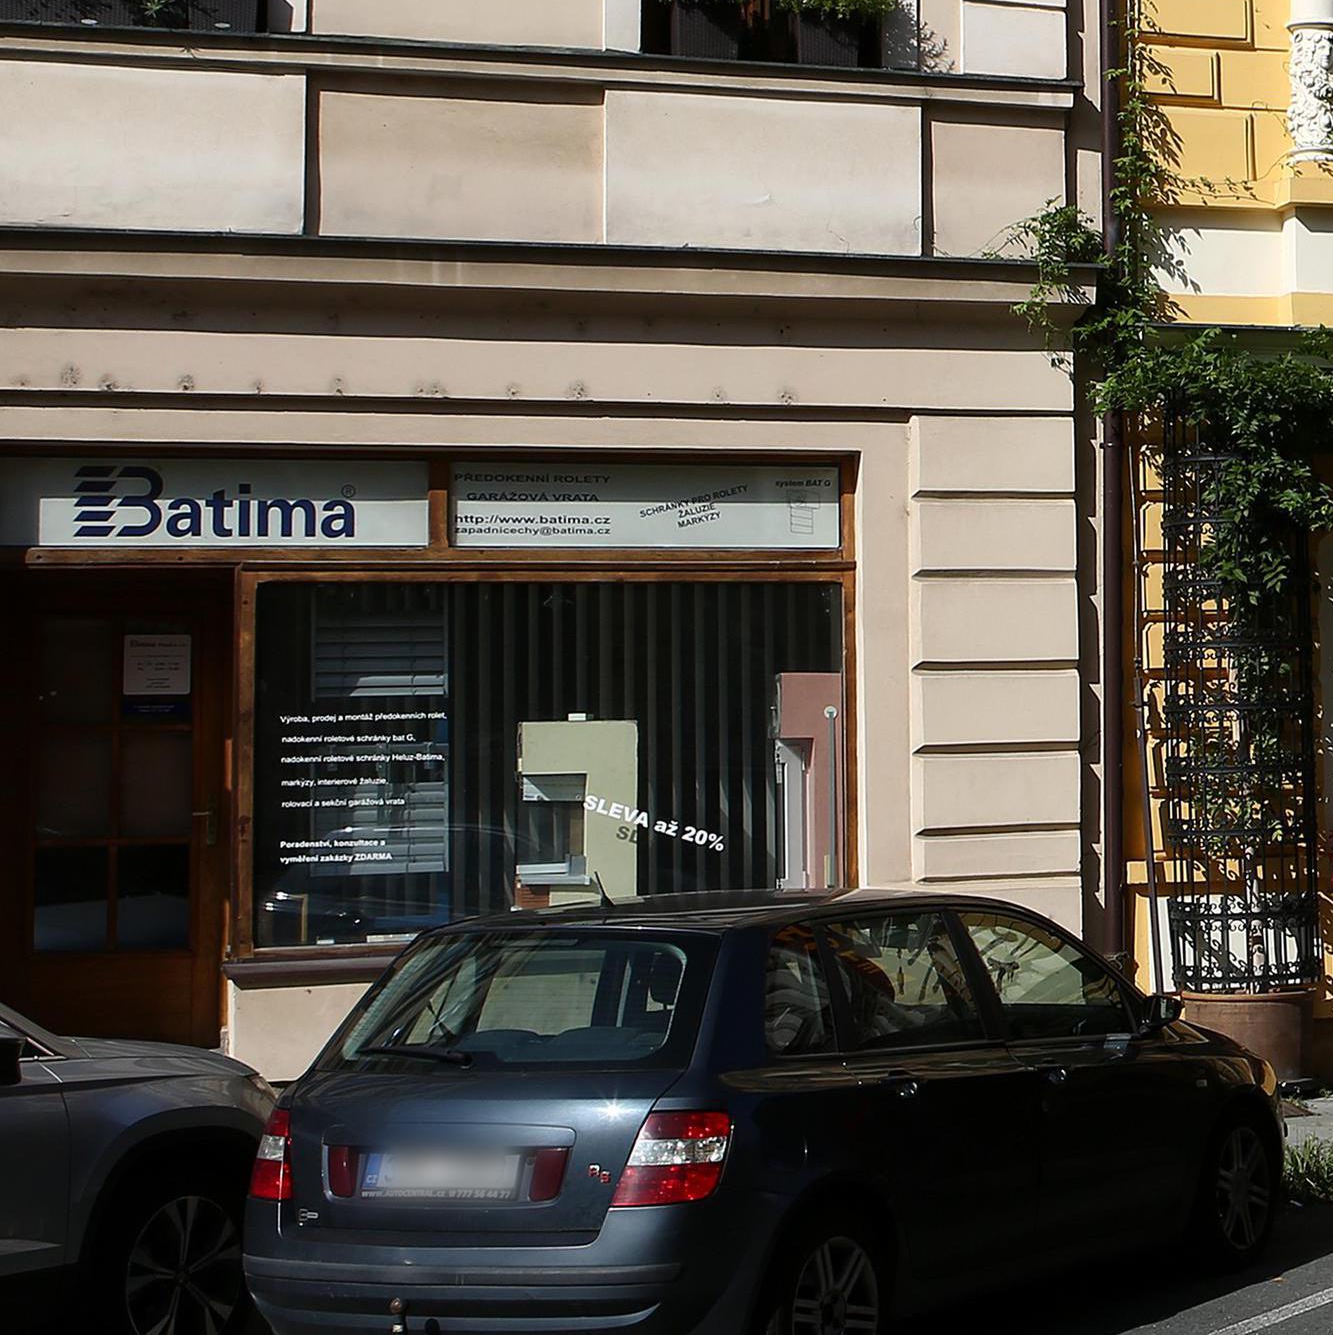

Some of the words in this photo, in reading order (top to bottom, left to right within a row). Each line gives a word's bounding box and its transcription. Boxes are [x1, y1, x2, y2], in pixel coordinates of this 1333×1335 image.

[454, 473, 549, 483] PŘEDOKENNÍ
[554, 474, 611, 483] ROLETY
[466, 492, 549, 502] GARÁŽOVÁ
[552, 493, 599, 502] VRATA
[691, 493, 711, 504] PRO
[713, 484, 749, 500] ROLETY
[73, 466, 355, 537] Batima
[455, 515, 611, 525] http://www.batima.cz
[455, 526, 611, 536] zapadnicechy@batima.cz
[312, 714, 337, 723] prodej
[385, 798, 405, 806] vrata
[583, 795, 649, 828] SLEVA
[654, 819, 679, 837] až
[681, 826, 724, 852] 20%
[333, 839, 378, 848] konzultace
[354, 853, 392, 861] ZDARMA
